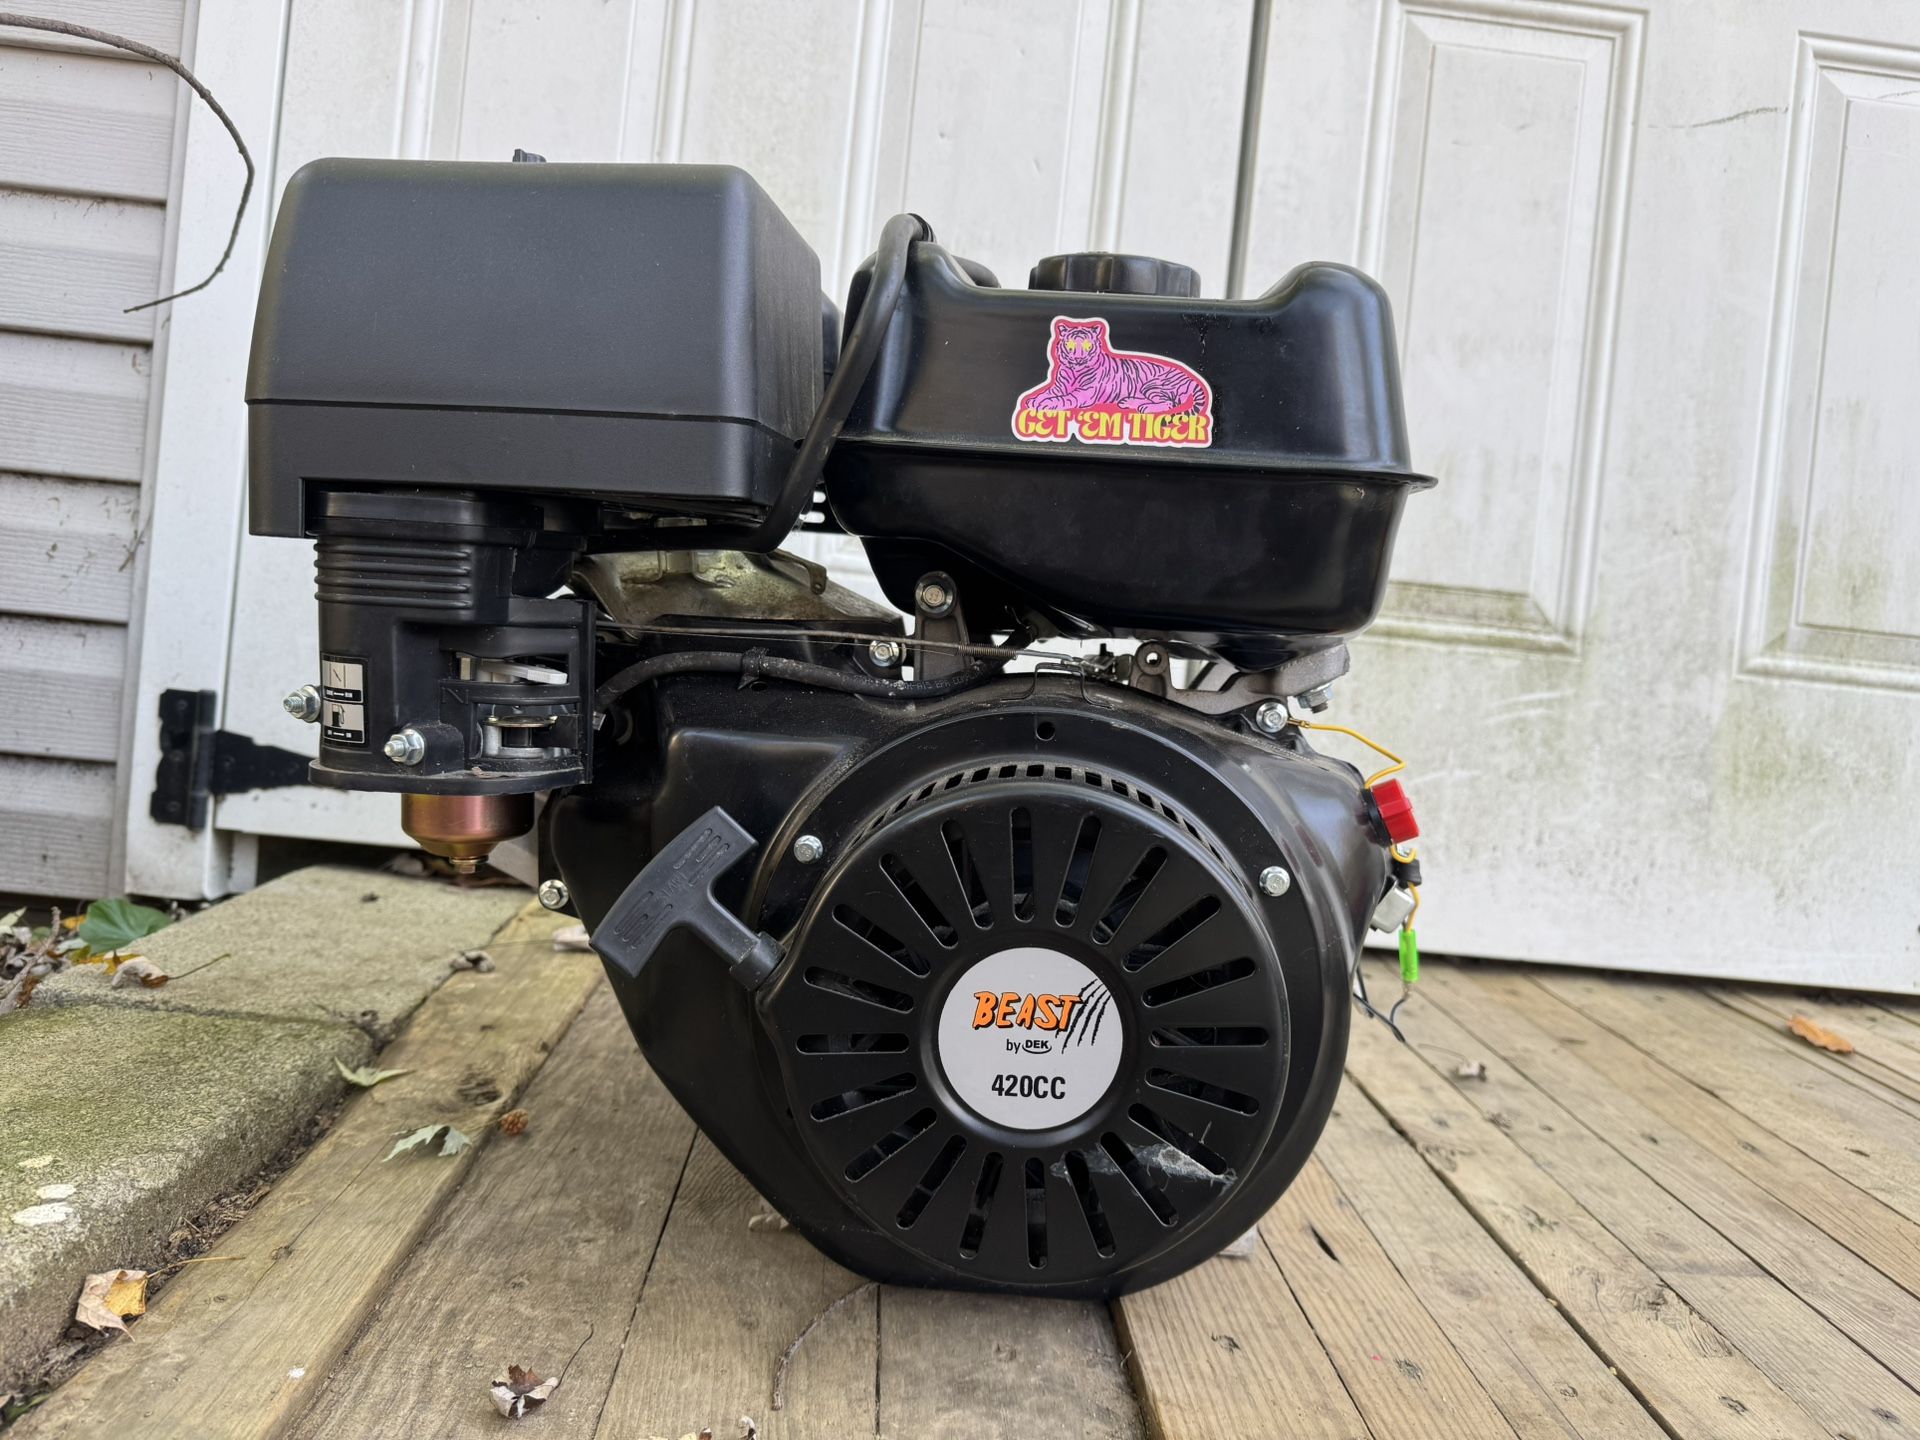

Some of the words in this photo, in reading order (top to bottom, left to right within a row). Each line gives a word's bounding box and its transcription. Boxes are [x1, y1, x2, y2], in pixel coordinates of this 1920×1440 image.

[1018, 408, 1071, 436] GET
[1128, 412, 1211, 441] TIGER
[971, 990, 1083, 1032] BEAST
[1006, 1038, 1021, 1055] by
[1024, 1039, 1050, 1050] DEK
[991, 1074, 1066, 1100] 420CC
